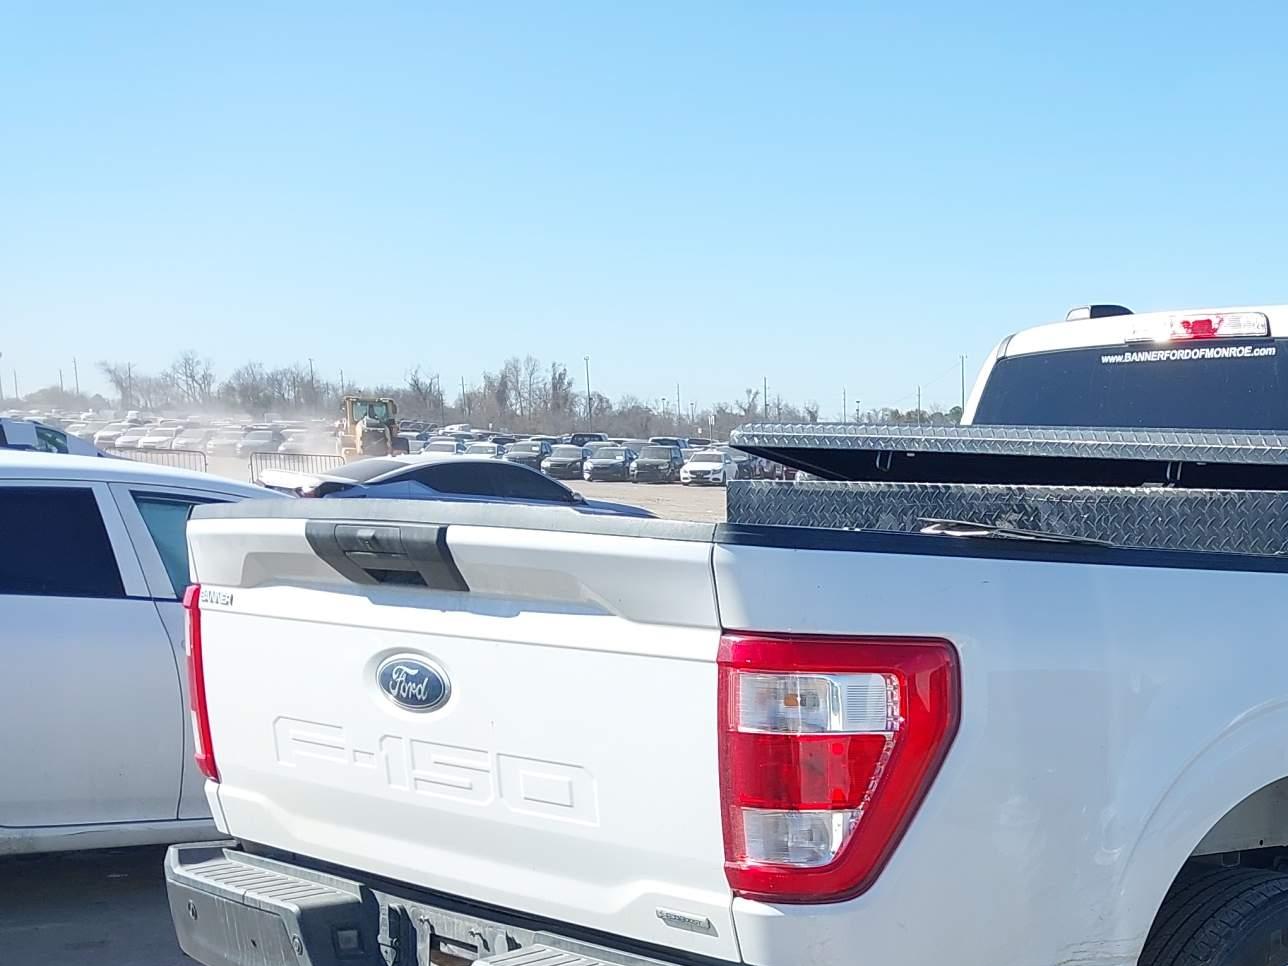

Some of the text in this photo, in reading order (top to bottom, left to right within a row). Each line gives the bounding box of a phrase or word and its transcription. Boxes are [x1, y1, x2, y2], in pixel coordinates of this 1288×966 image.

[1101, 346, 1276, 363] www.BANNERFORDOFMONROE.com
[389, 665, 428, 700] Ford
[273, 715, 600, 827] F-150
